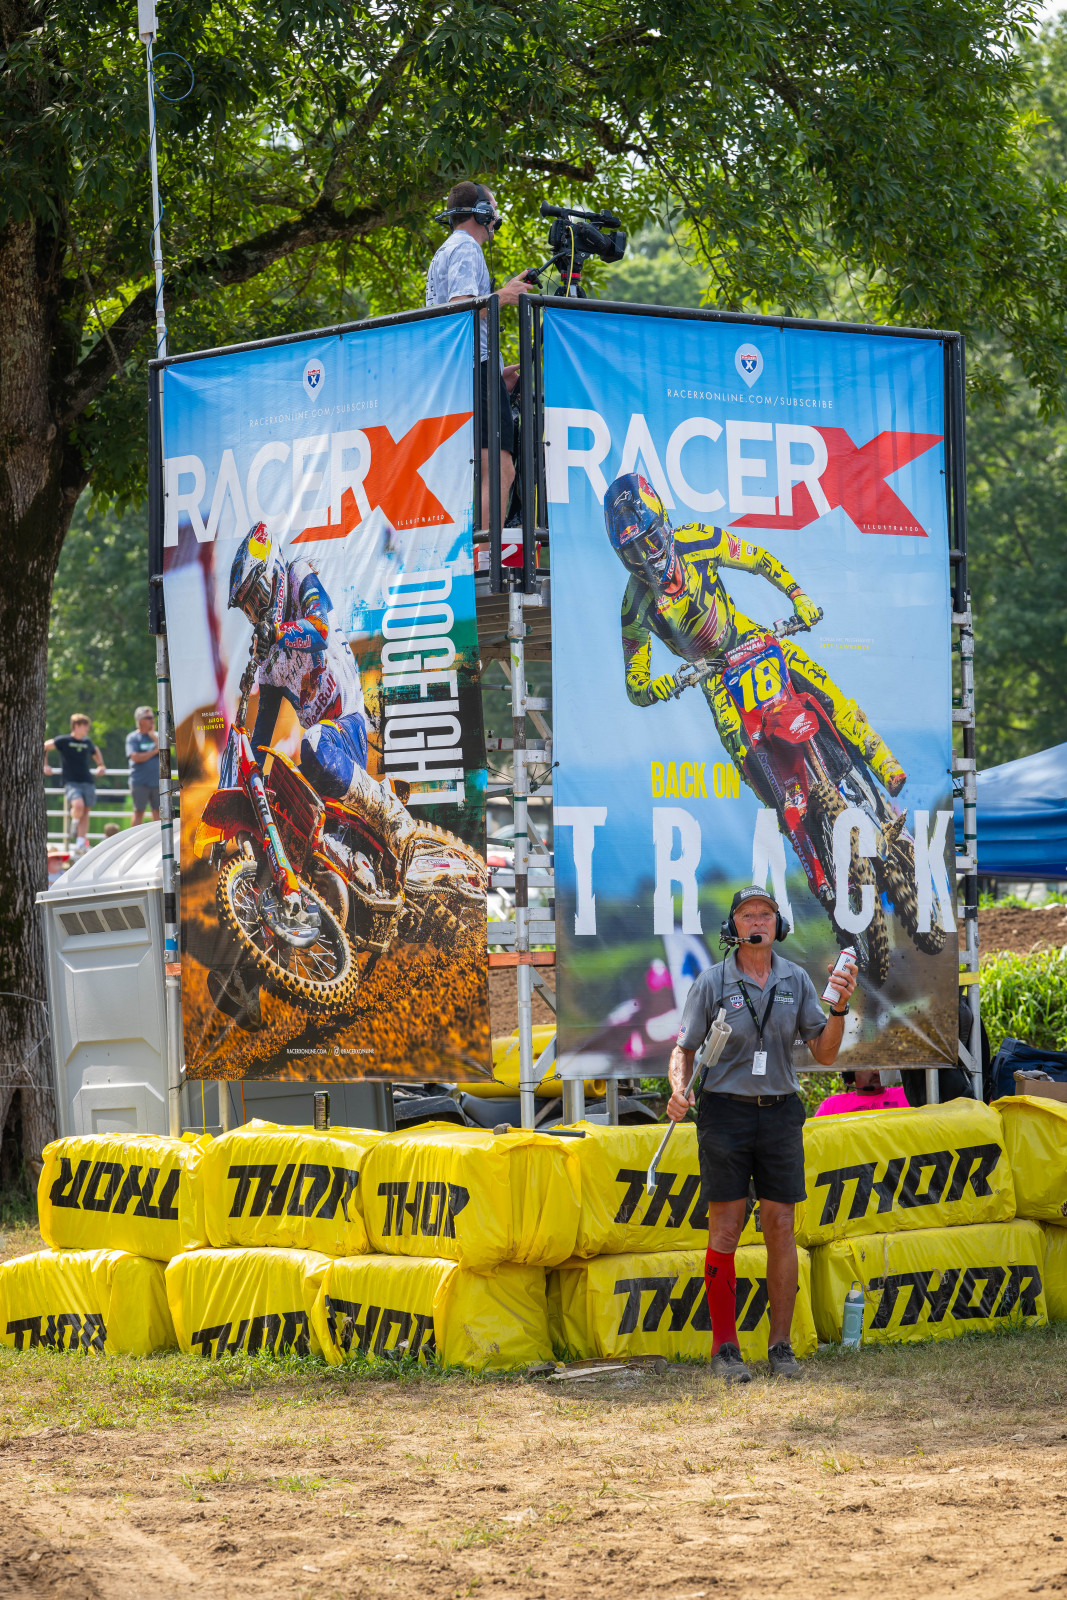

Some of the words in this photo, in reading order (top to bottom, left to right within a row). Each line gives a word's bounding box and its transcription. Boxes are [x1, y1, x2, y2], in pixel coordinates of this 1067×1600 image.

[667, 388, 833, 409] RACERXONLINE.COM/SUBSCRIBE
[397, 514, 445, 526] ILLUSTRATED
[863, 524, 919, 532] ILLUSTRATED
[317, 673, 337, 708] Bull
[381, 567, 466, 811] DOGFIGHT
[739, 657, 782, 713] 18
[651, 762, 708, 798] BACK
[713, 762, 740, 799] ON
[553, 806, 958, 936] TRACK
[790, 829, 814, 879] DUNLOP
[49, 1157, 182, 1220] THOR
[227, 1163, 361, 1223] THOR
[377, 1181, 470, 1240] THOR
[613, 1168, 763, 1232] TH
[814, 1143, 1002, 1226] THOR
[867, 1264, 1044, 1330] THOR
